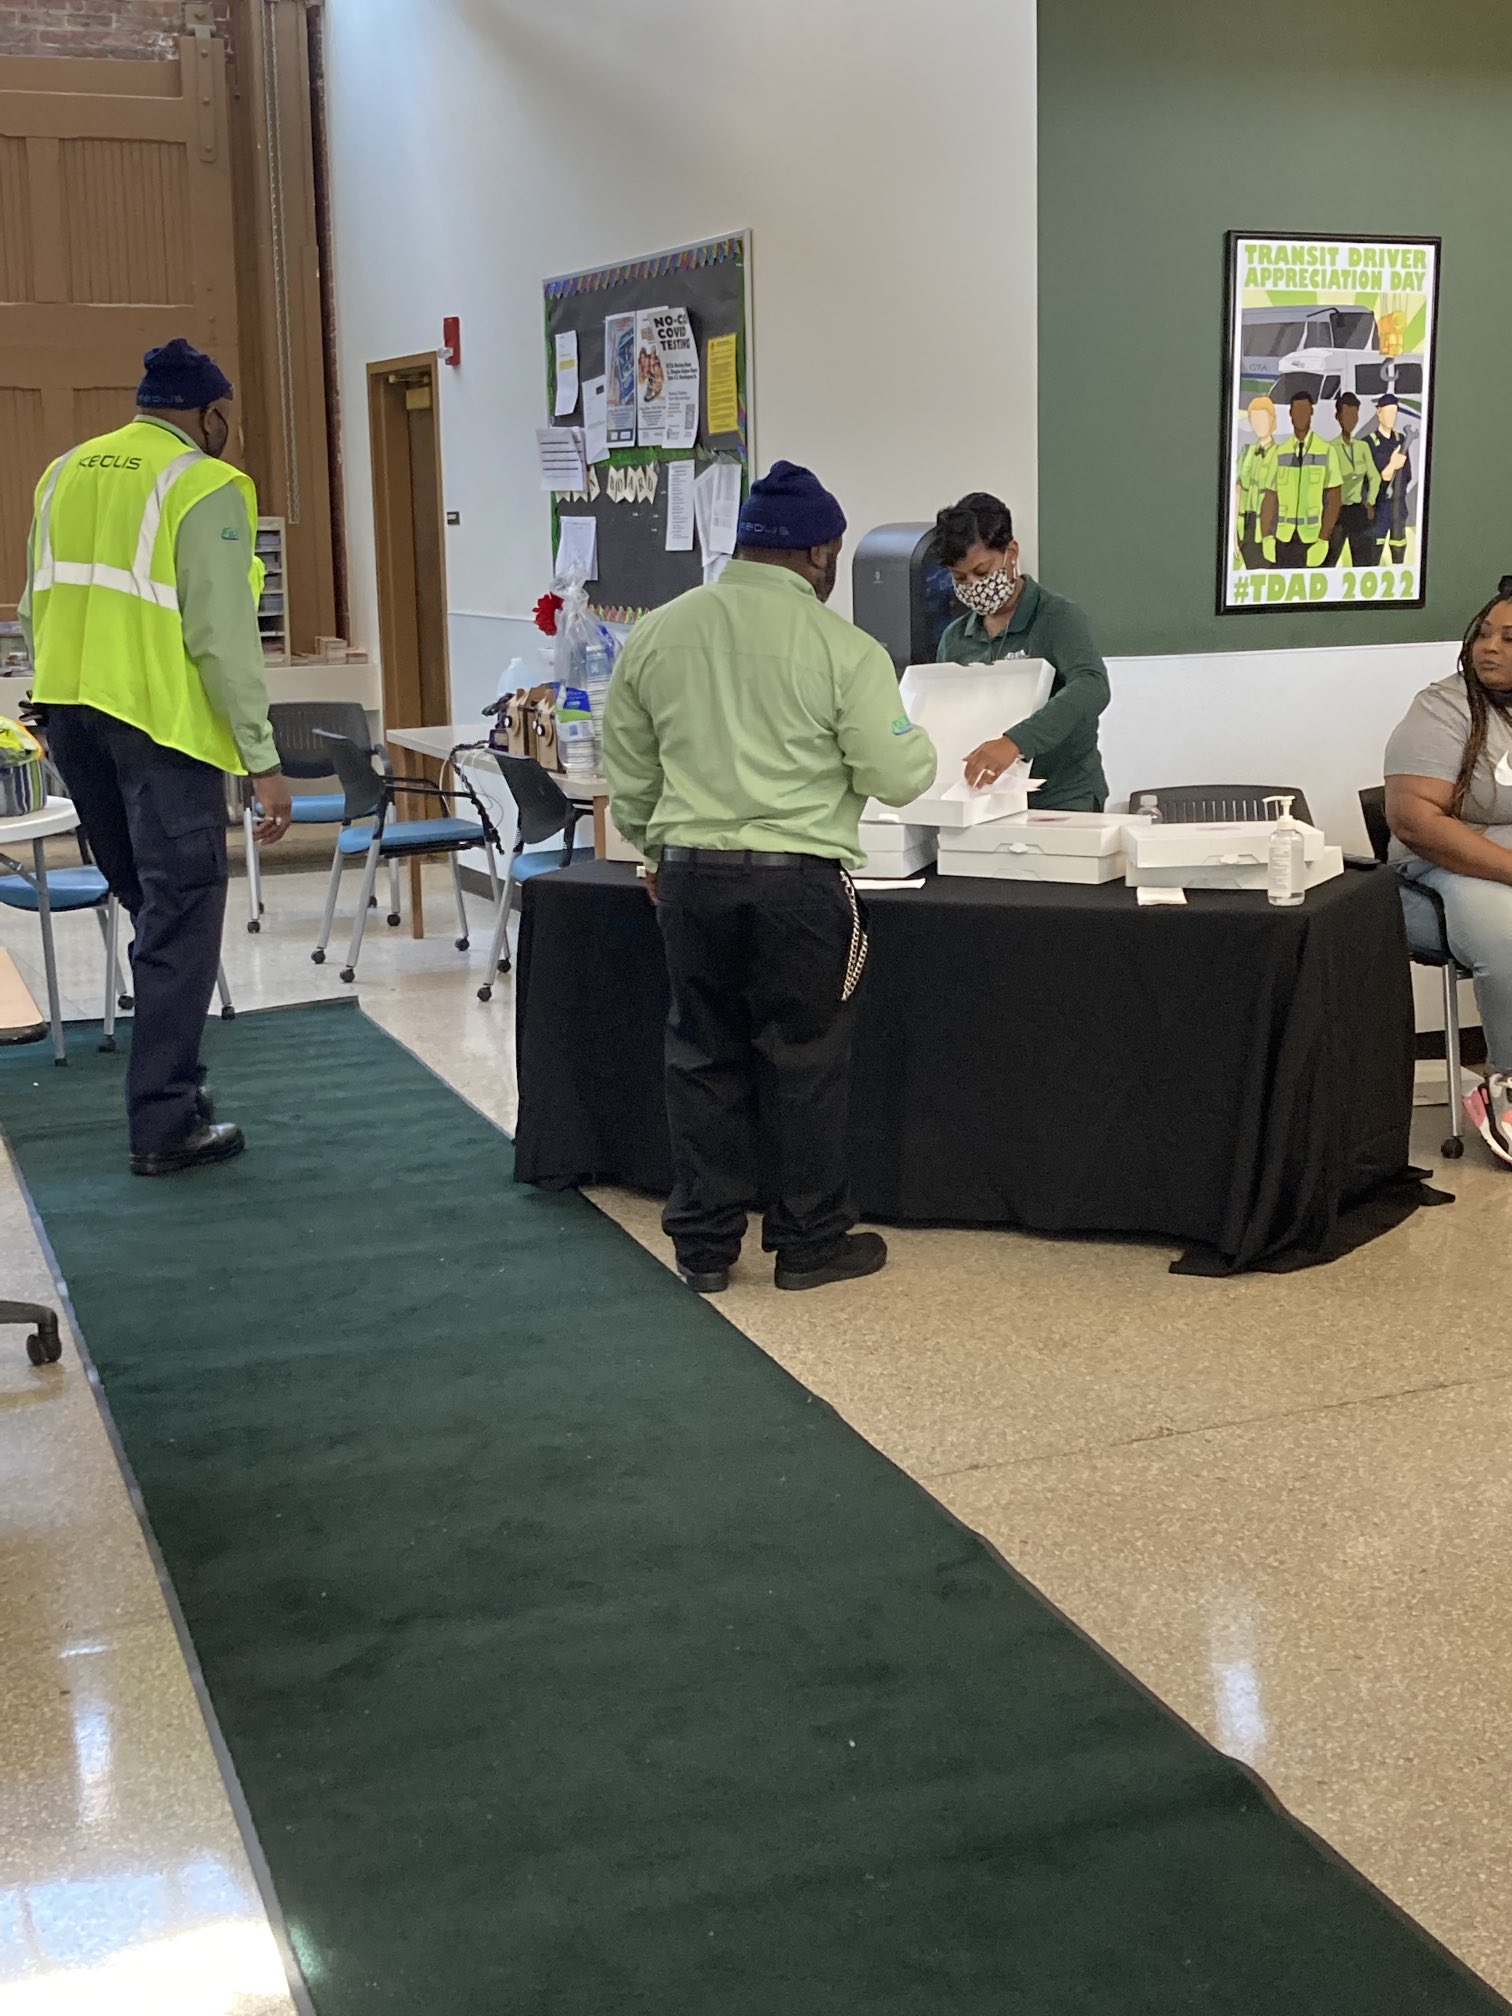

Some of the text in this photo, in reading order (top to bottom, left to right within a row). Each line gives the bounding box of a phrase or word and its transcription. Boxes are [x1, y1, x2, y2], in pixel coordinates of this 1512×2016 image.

[1244, 244, 1427, 270] TRANSIT DRIVER
[1244, 267, 1427, 291] APPRECIATION DAY
[658, 326, 687, 339] COVID
[660, 338, 691, 351] TESTING
[1234, 570, 1414, 603] #TDAD 2022
